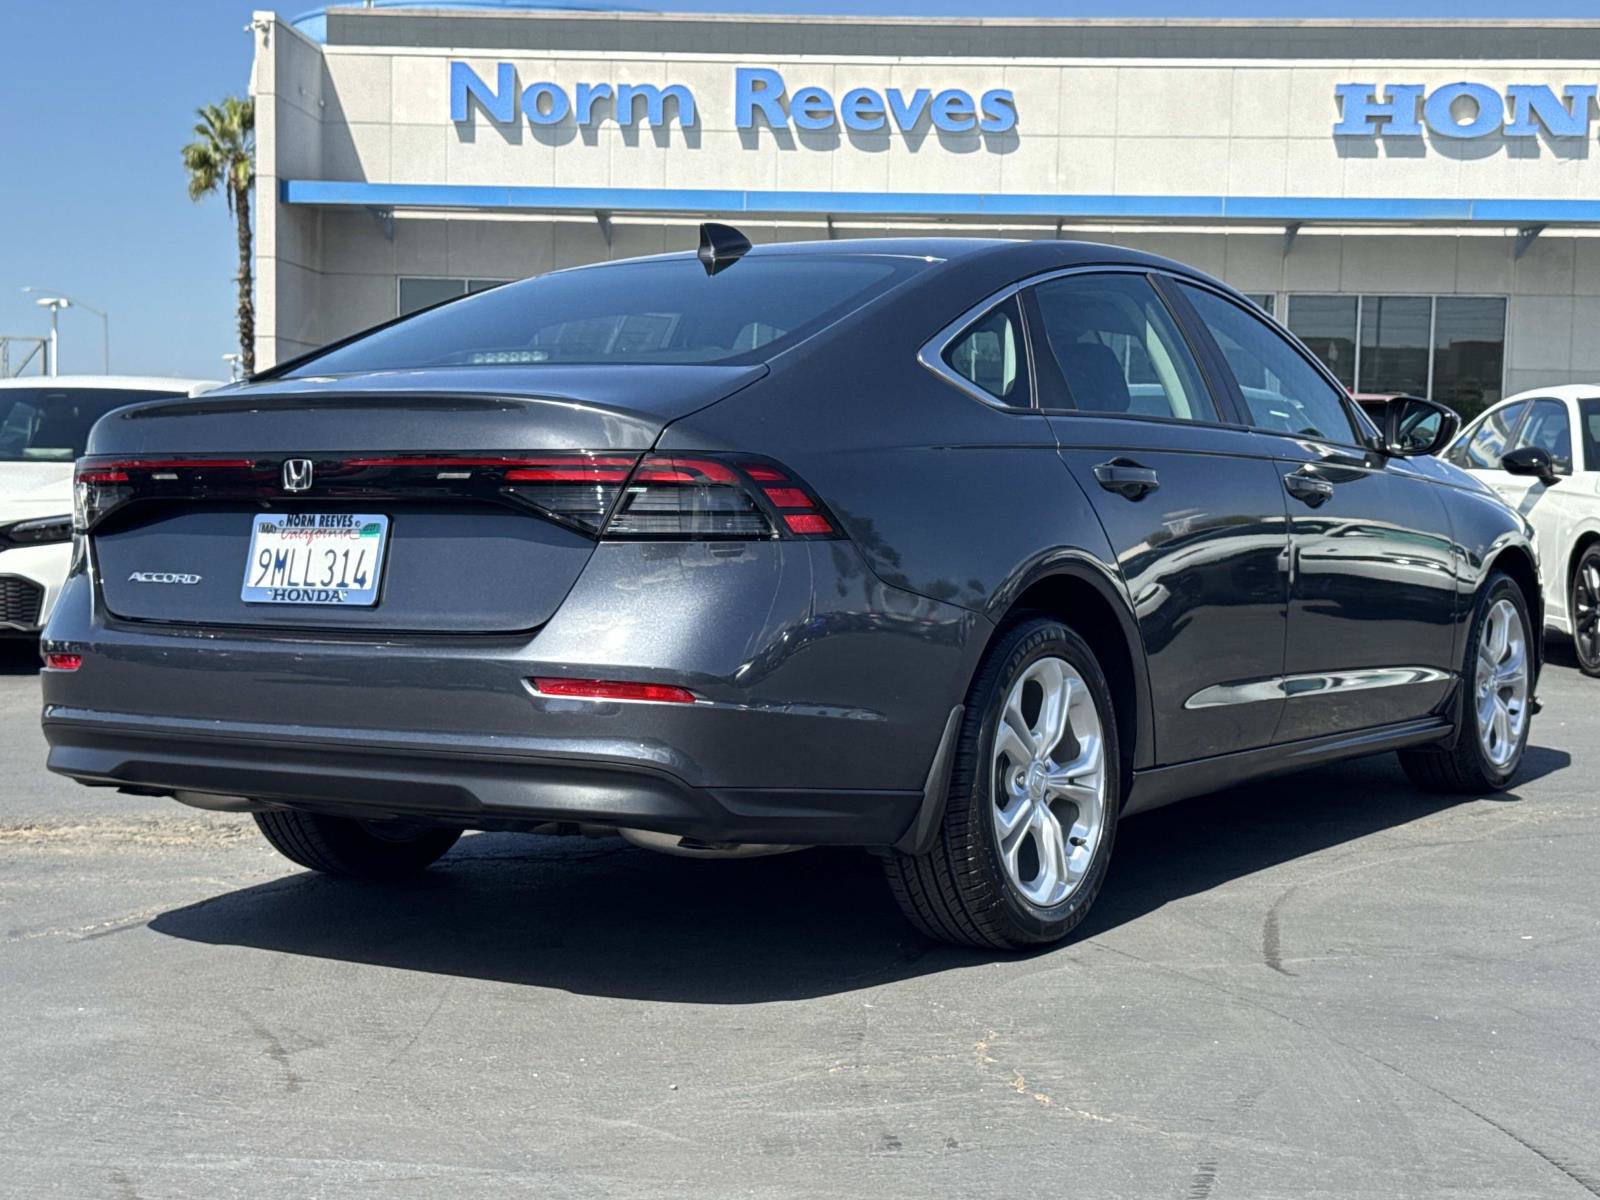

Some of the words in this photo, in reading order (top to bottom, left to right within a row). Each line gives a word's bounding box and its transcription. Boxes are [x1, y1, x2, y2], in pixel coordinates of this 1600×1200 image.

[450, 61, 696, 127] Norm
[734, 67, 1018, 133] Reeves
[1333, 82, 1600, 138] HON
[286, 514, 316, 527] NORM
[319, 515, 354, 528] REEVES
[128, 571, 202, 584] ACCORD
[254, 548, 368, 588] 9MLL314
[271, 588, 345, 602] HONDA
